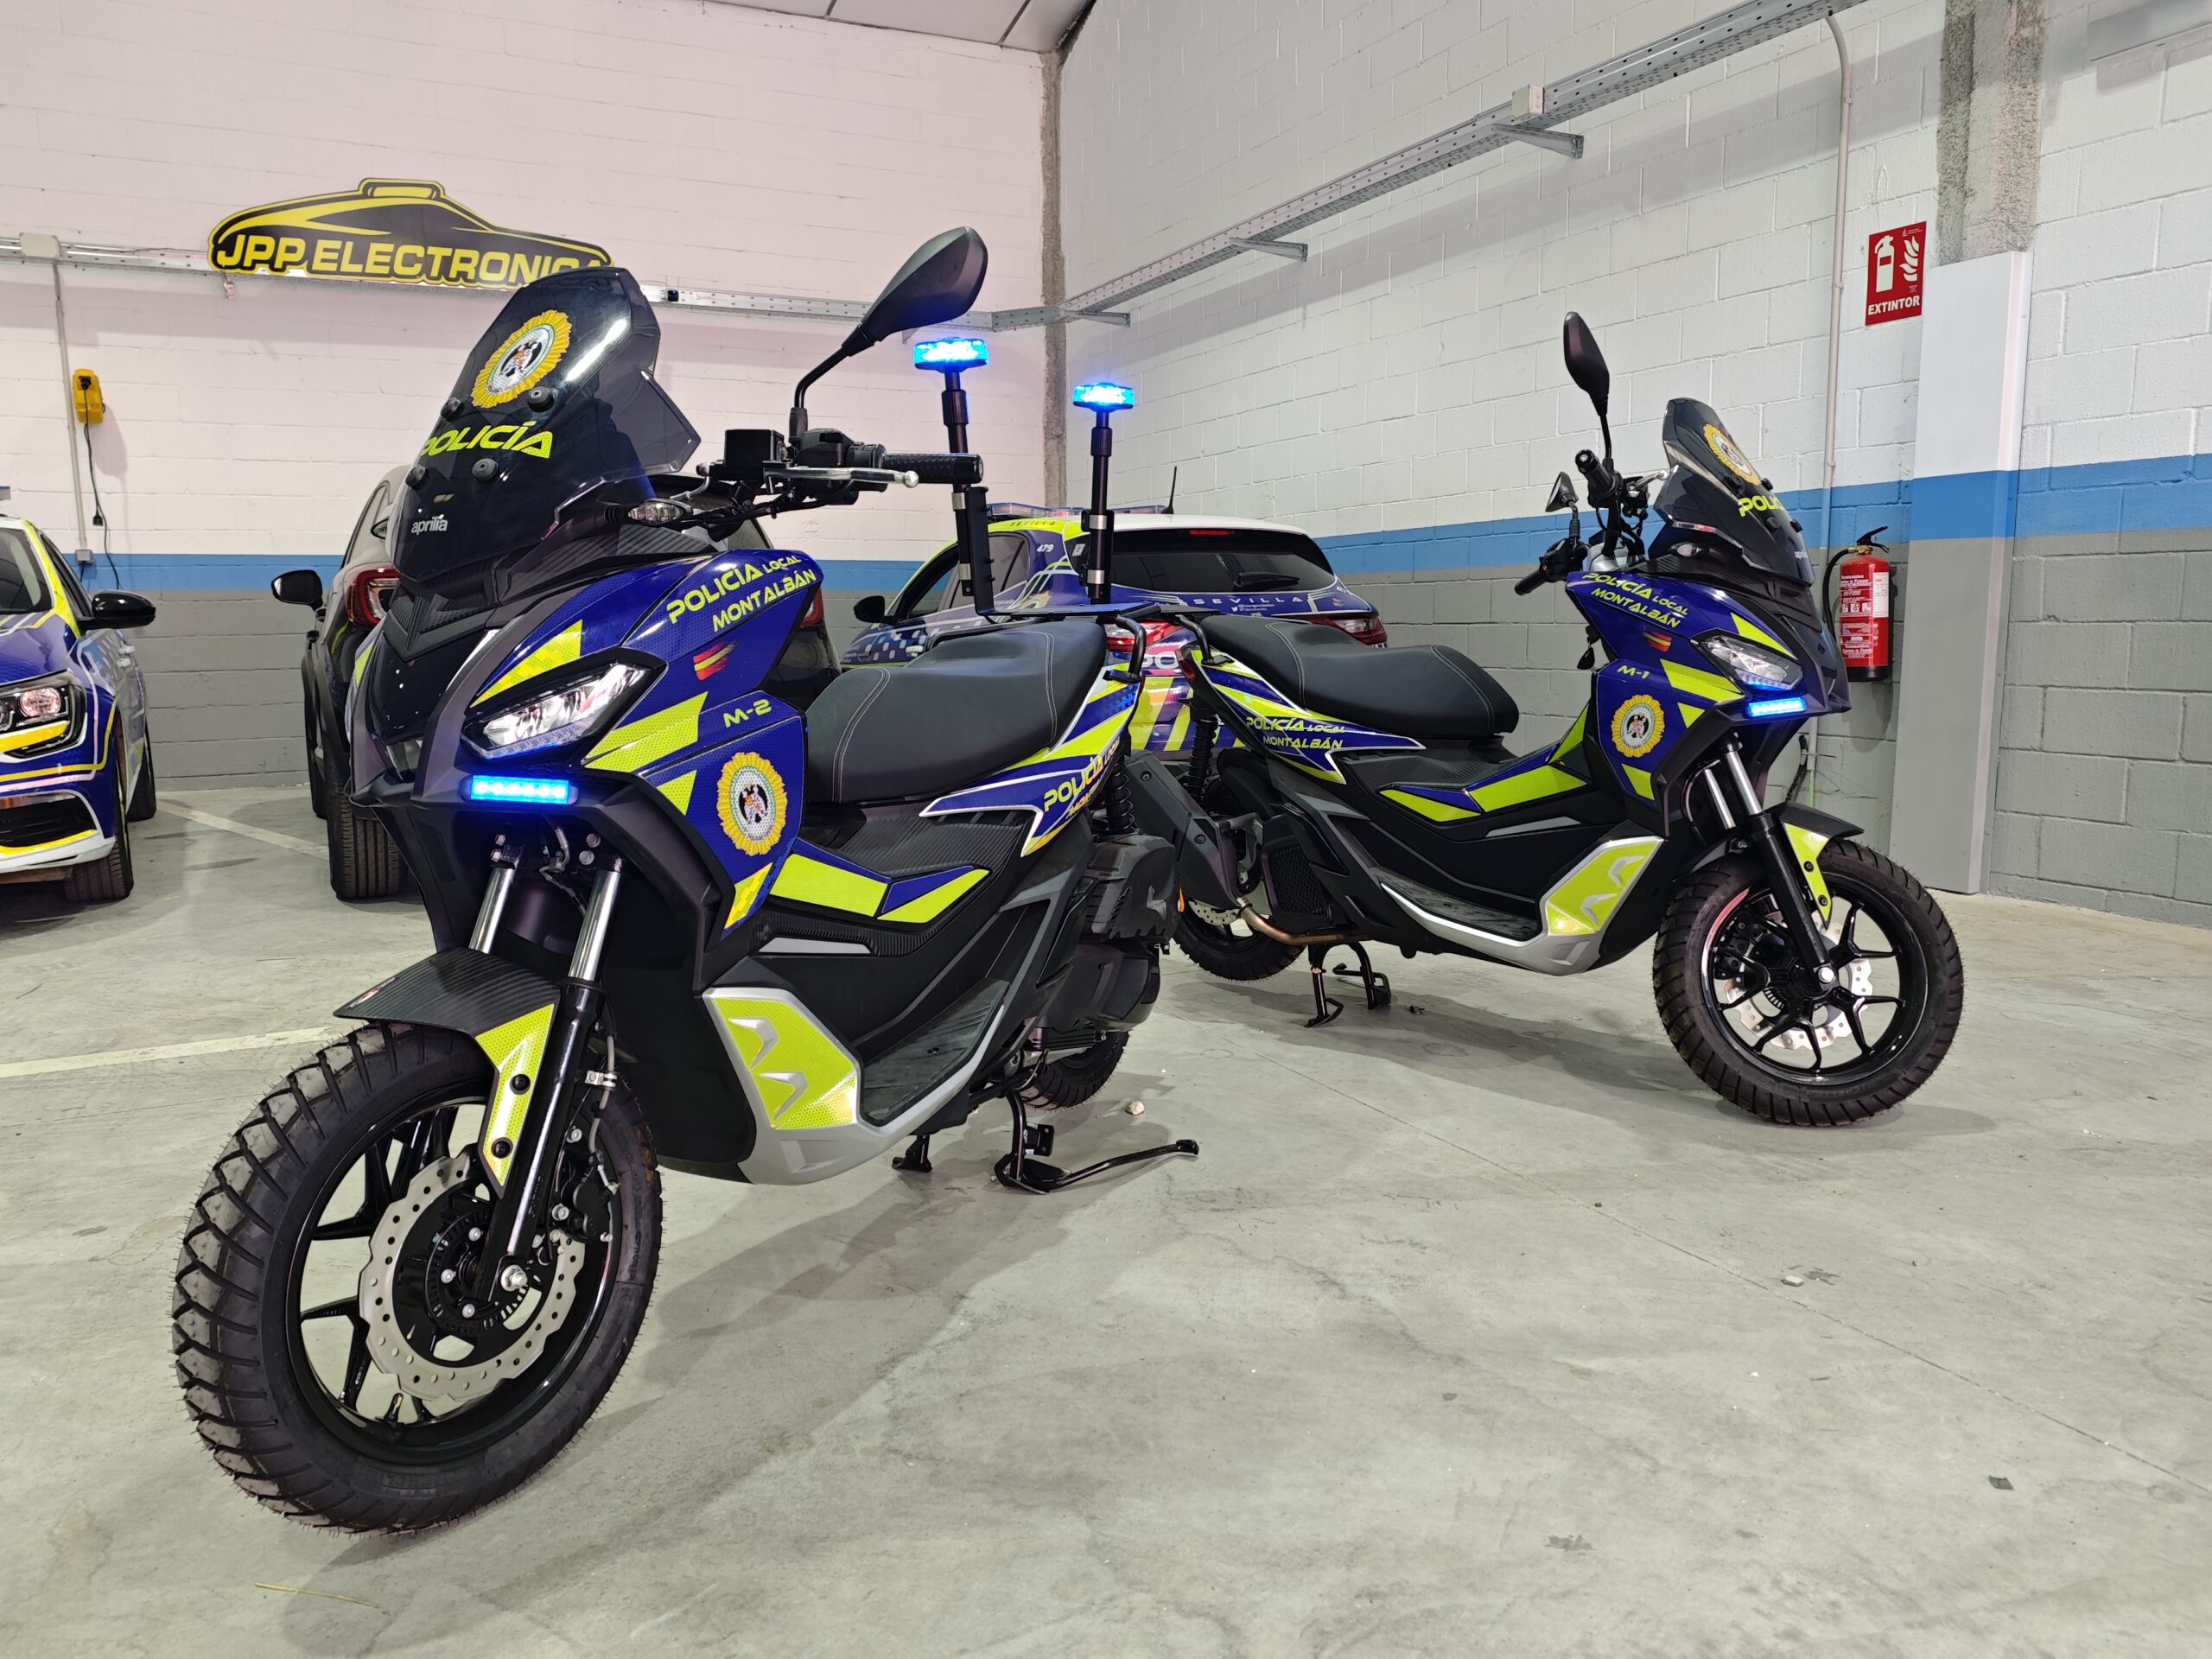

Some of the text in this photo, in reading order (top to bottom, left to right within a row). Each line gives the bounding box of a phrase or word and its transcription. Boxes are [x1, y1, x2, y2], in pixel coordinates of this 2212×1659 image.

[217, 234, 601, 286] JPP ELECTRONI
[1867, 296, 1920, 315] EXTINTOR
[421, 421, 553, 458] POLICÍA
[411, 514, 448, 535] aprilia
[666, 556, 802, 624] POLICÍA LOCAL
[712, 569, 817, 632] MONTALBÁN
[1582, 572, 1688, 615] POLICÍA LOCAL
[1591, 588, 1681, 628] MONTALBÁN
[1617, 664, 1650, 679] M-1
[722, 698, 772, 728] M-2
[1245, 717, 1346, 733] POLICÍA LOCAL
[1262, 735, 1344, 749] MONTALBÁN
